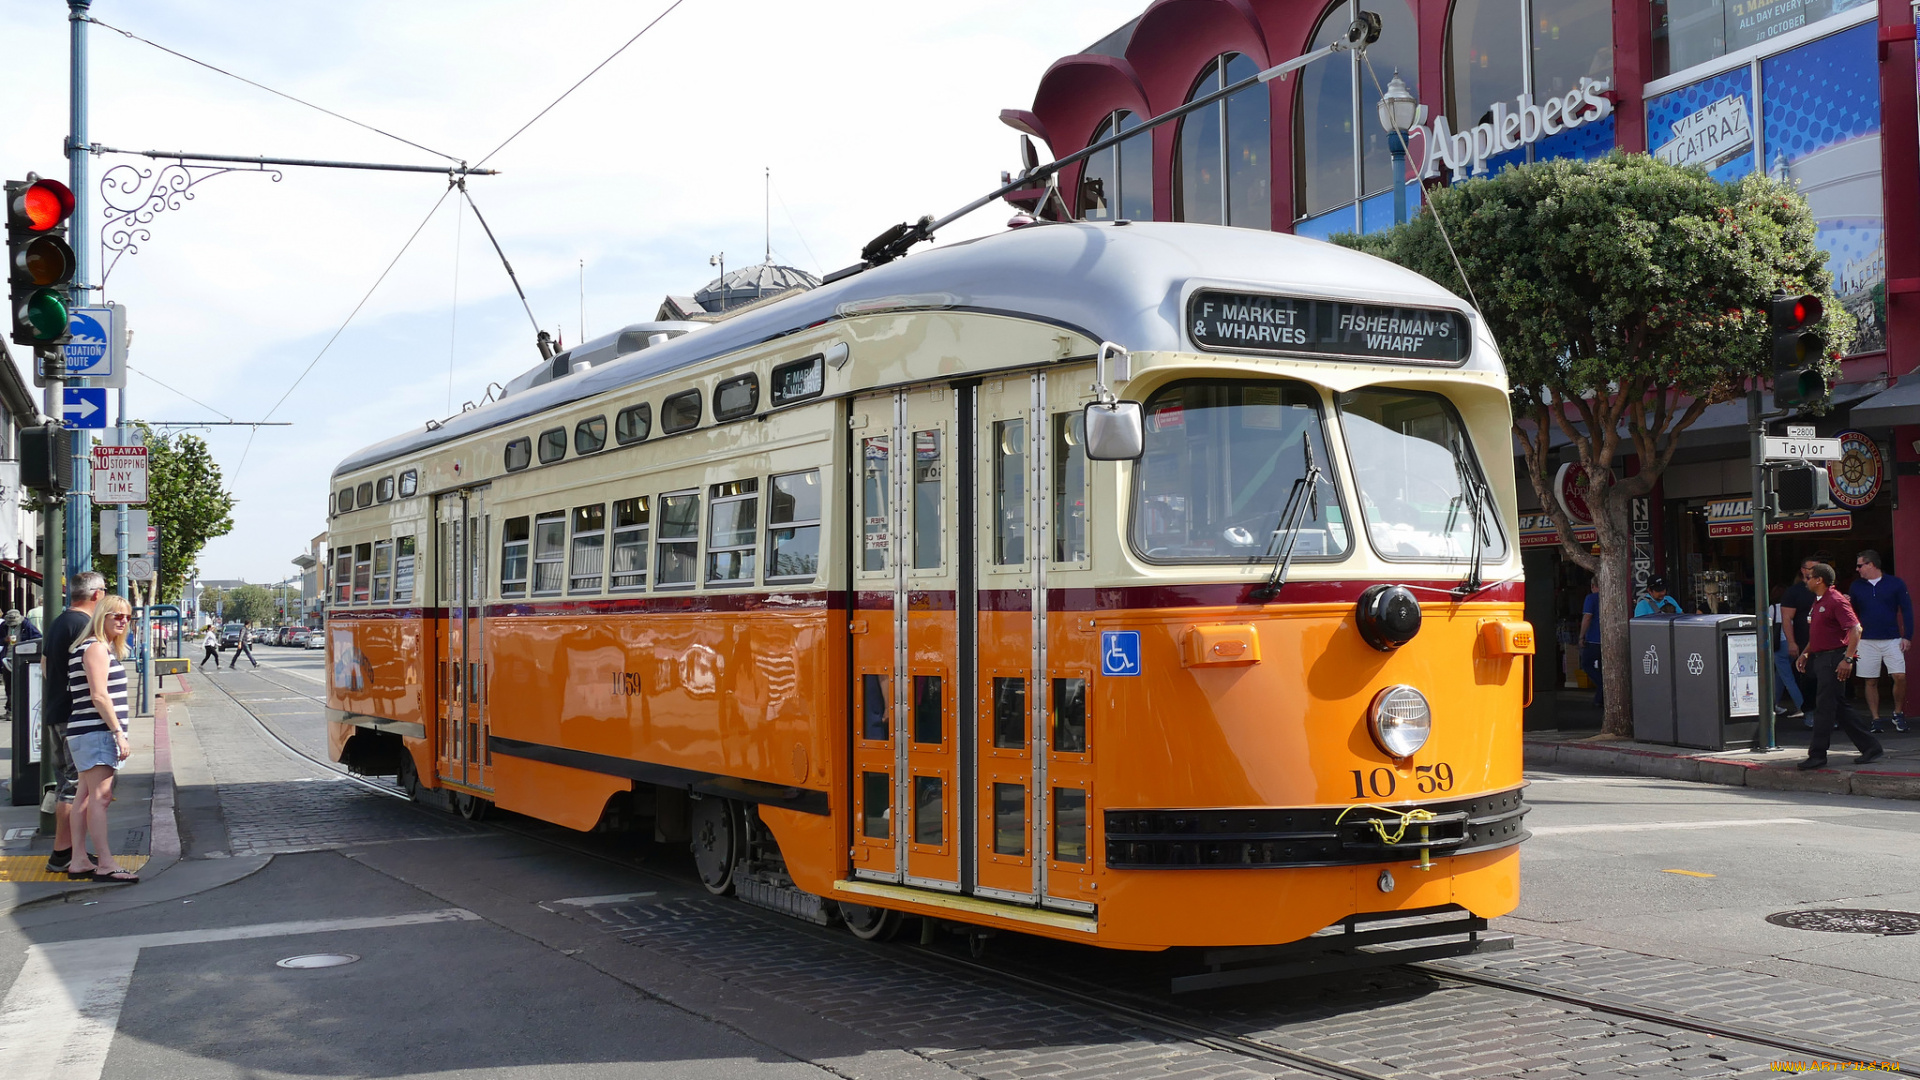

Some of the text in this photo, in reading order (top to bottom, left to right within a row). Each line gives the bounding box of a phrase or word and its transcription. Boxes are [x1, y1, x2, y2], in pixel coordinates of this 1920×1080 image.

[1739, 0, 1801, 29] ALL DAY EVERY
[1767, 14, 1805, 37] OCTOBER
[1425, 76, 1612, 183] Applebee's
[1673, 102, 1717, 136] VIEW
[1668, 107, 1747, 166] LCATRAZ
[1203, 302, 1298, 325] F MARKET
[1194, 320, 1306, 345] & WHARVES
[1339, 314, 1450, 338] FISHERMAN'S
[65, 345, 102, 356] CUATION
[1366, 333, 1424, 352] WHARF
[785, 366, 820, 385] F MARKE
[1782, 442, 1825, 457] Taylor
[94, 456, 145, 469] NO STOPPING
[108, 483, 133, 492] TIME
[109, 471, 131, 481] ANY
[1836, 475, 1875, 496] CENTRAL
[1711, 526, 1732, 534] GIFTS
[1793, 519, 1848, 529] SPORTSWEAR
[1633, 521, 1650, 601] BILLABON
[612, 672, 641, 696] 1059
[1349, 762, 1454, 799] 10 59
